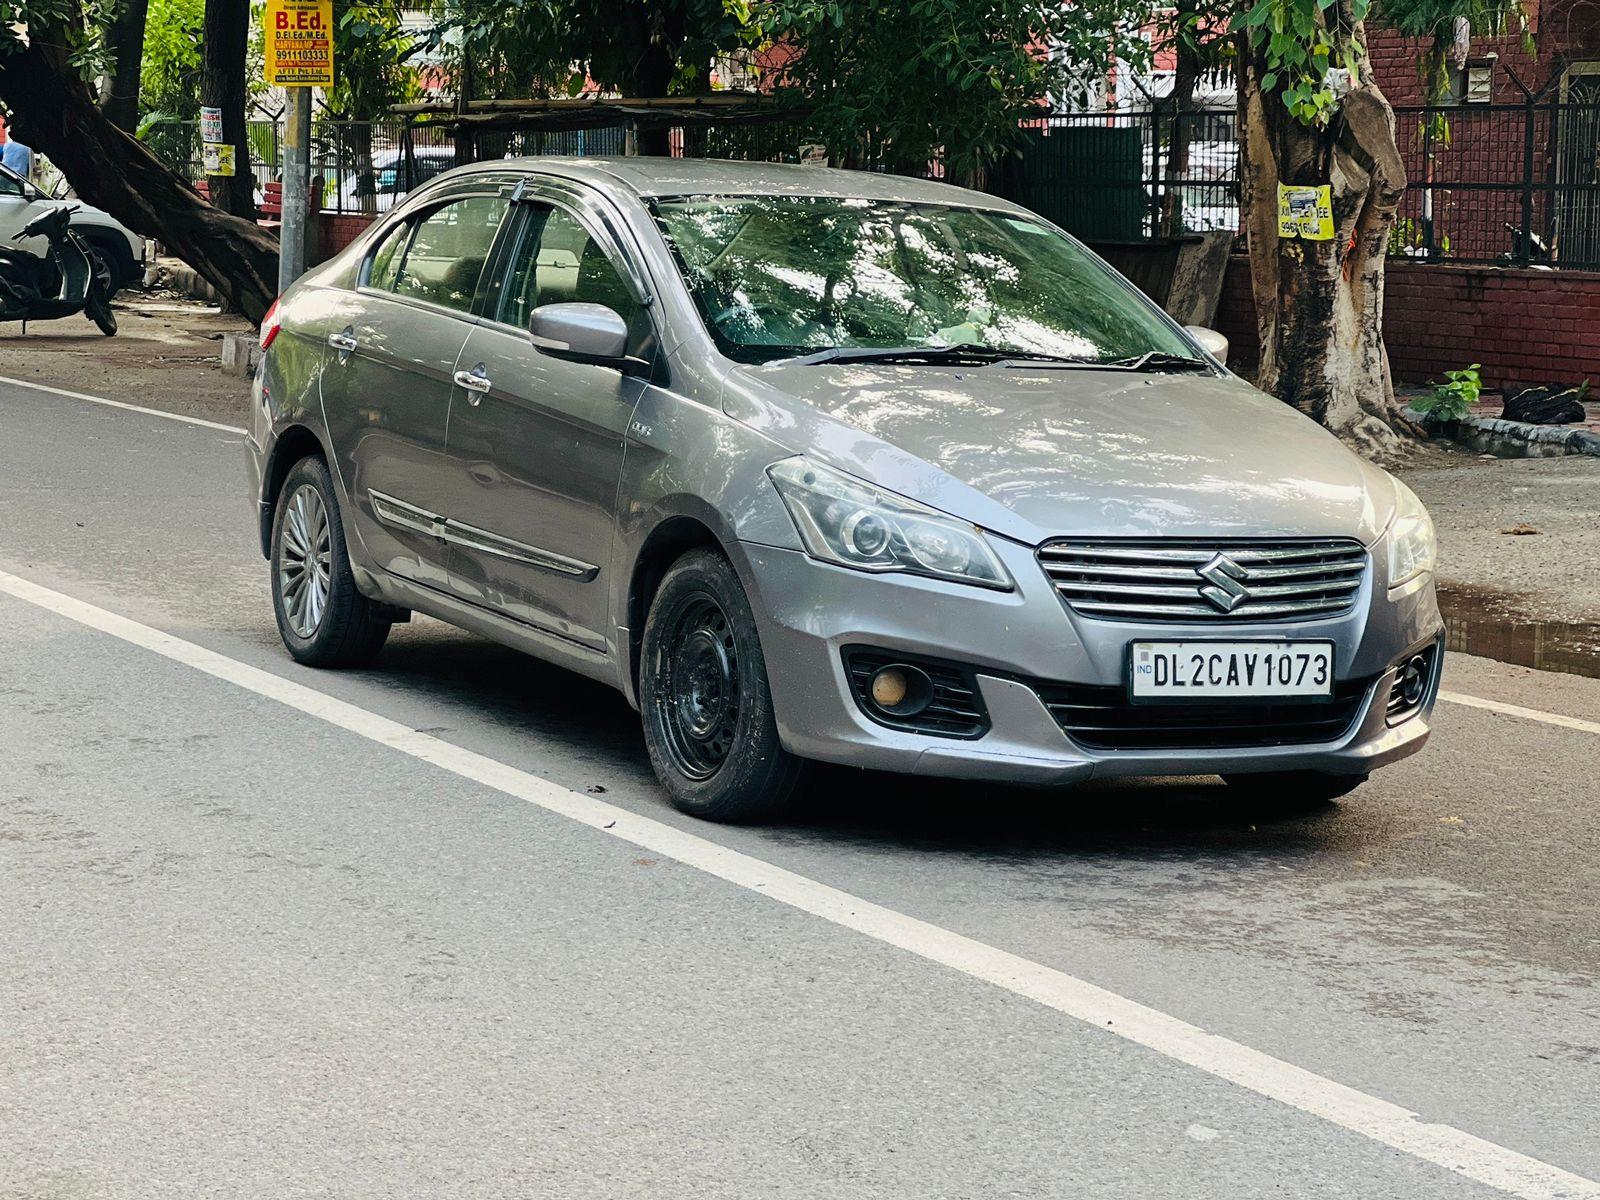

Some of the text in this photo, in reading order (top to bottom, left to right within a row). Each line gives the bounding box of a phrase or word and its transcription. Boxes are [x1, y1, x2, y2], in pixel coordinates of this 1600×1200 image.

[276, 11, 327, 29] B.Ed.
[276, 50, 329, 60] 9911103333
[1136, 665, 1152, 674] IND
[1154, 653, 1329, 687] DL2CAV1073
